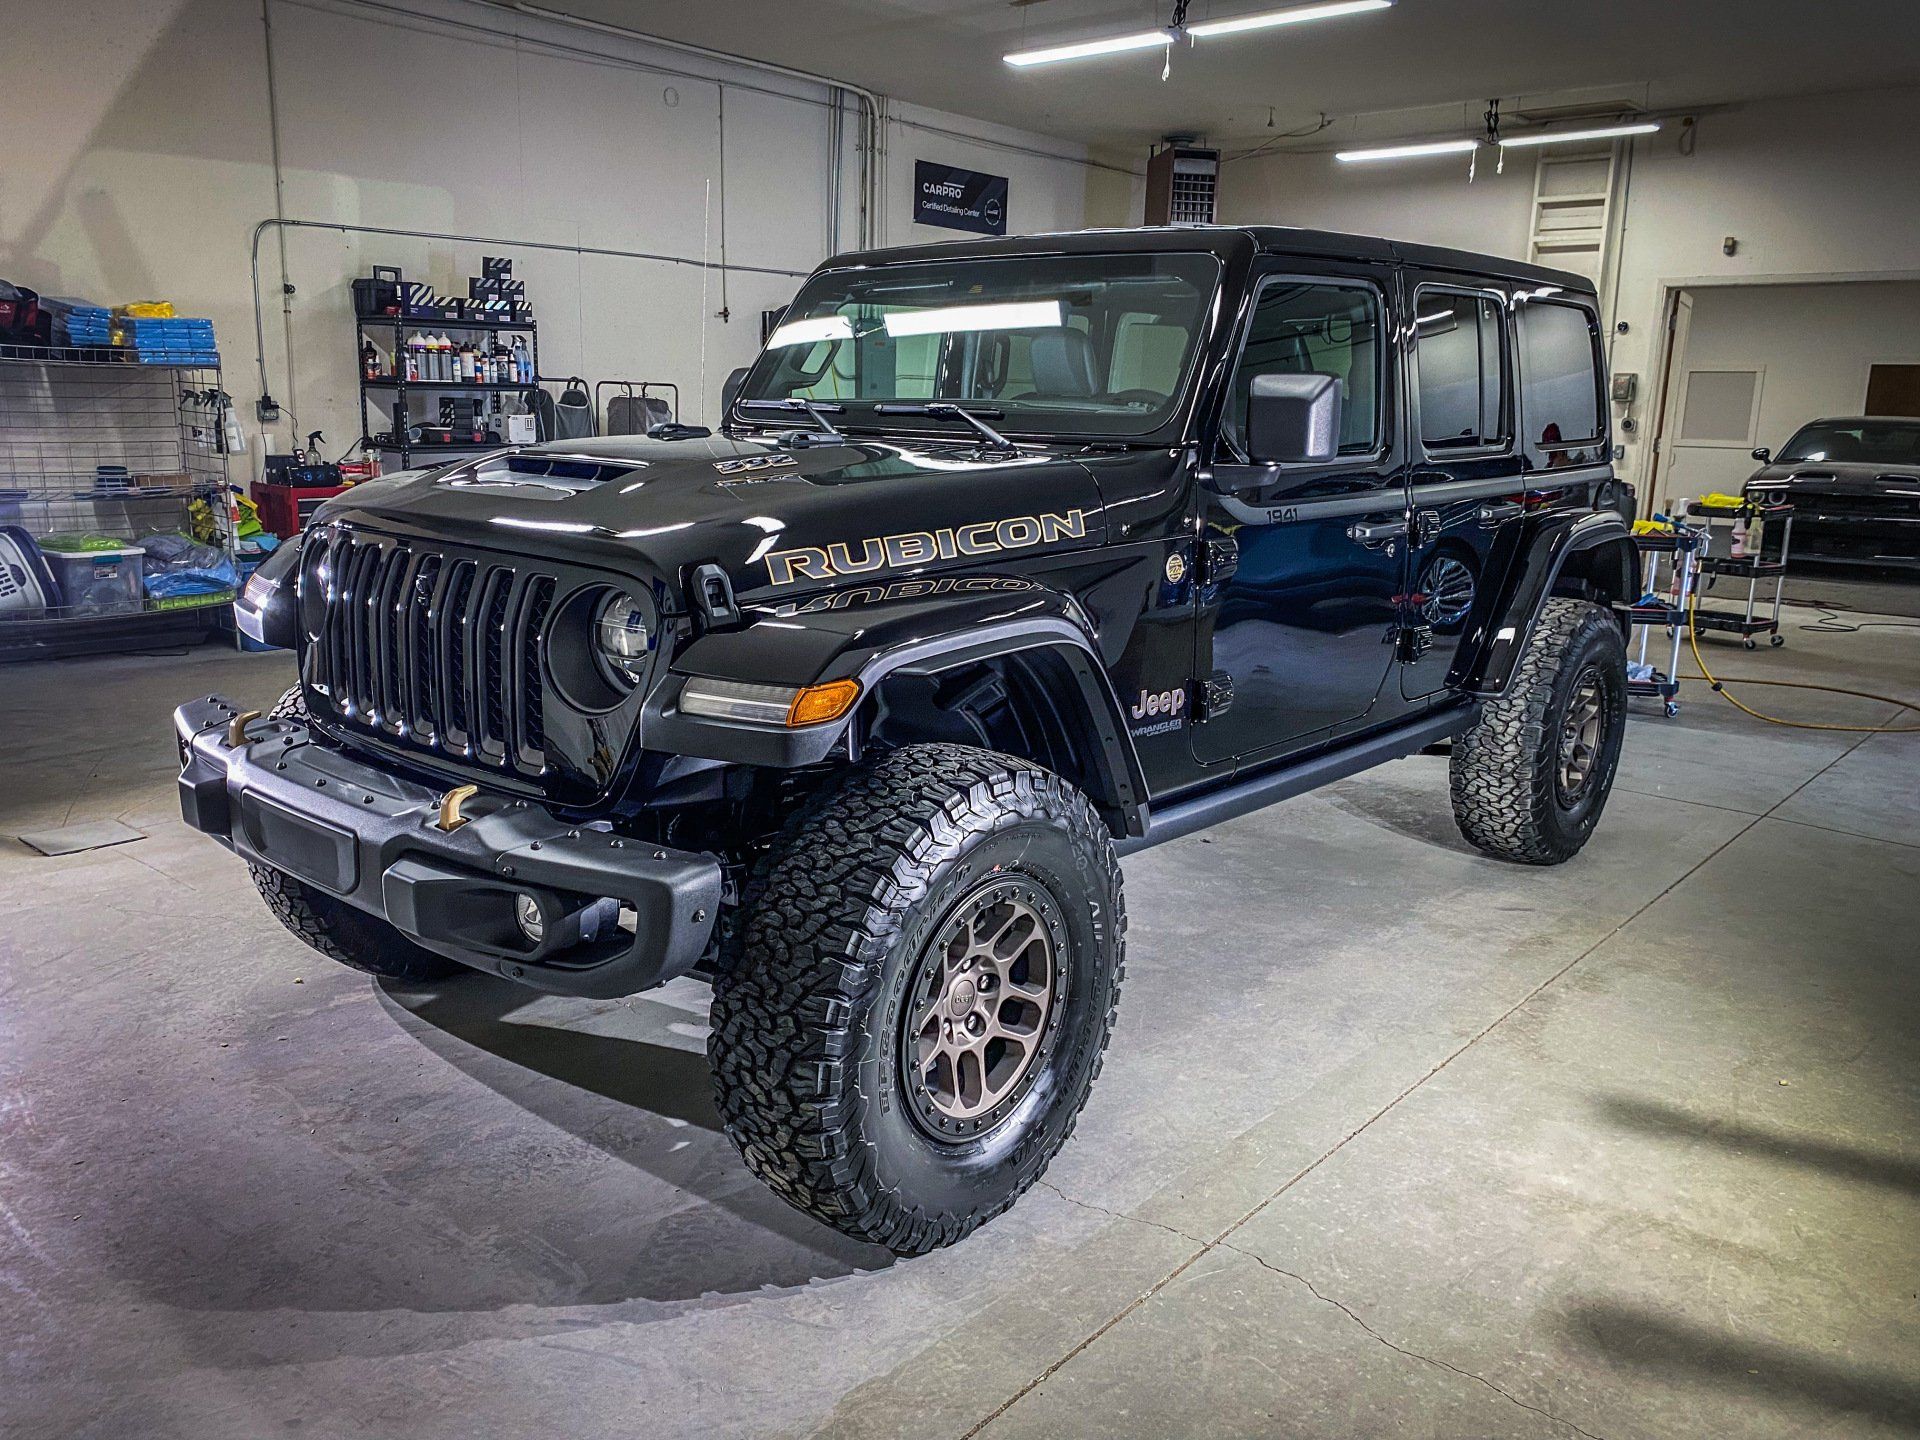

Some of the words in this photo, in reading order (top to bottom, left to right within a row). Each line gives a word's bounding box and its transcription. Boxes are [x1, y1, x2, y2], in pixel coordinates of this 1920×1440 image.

[923, 183, 962, 199] CARPRO
[922, 201, 943, 212] Certified
[964, 207, 980, 217] Center
[1266, 507, 1298, 524] 1941
[764, 509, 1085, 585] RUBICON
[1131, 688, 1185, 720] Jeep
[1131, 719, 1182, 737] WRANGLER
